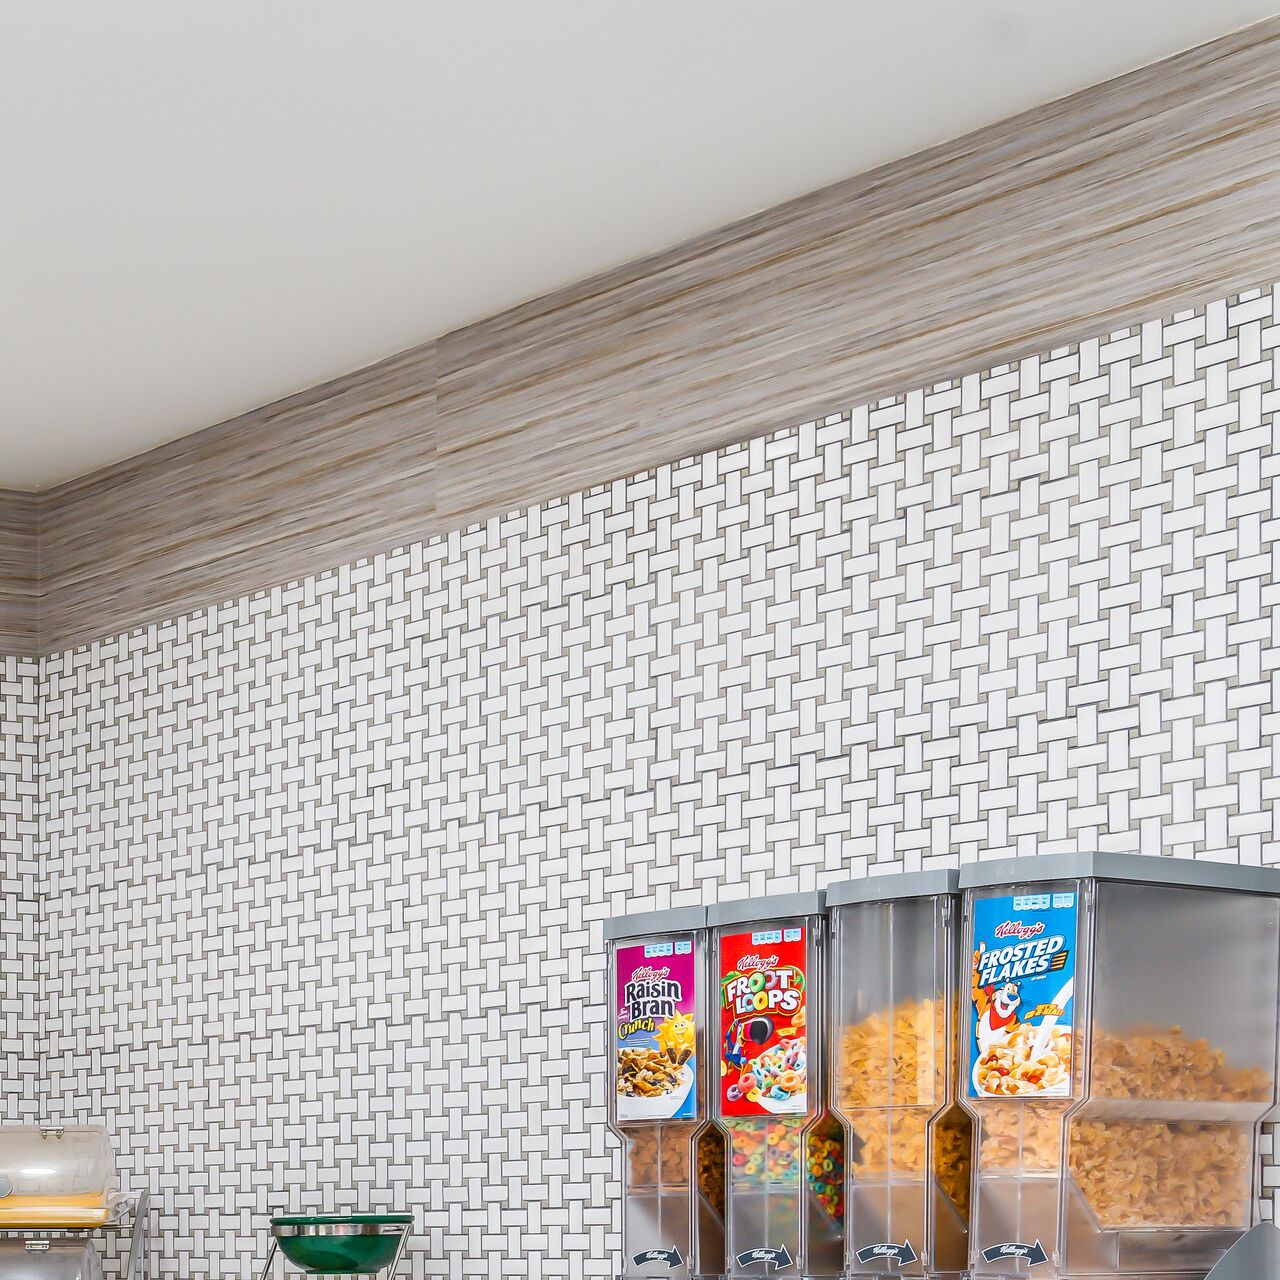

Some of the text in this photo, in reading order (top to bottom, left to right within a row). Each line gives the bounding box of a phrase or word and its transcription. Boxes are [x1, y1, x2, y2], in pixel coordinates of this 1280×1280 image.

[995, 921, 1046, 940] Kellogg's
[737, 954, 779, 971] Kellogg's
[979, 936, 1065, 972] FROSTED
[632, 966, 670, 982] Kellogg's
[979, 954, 1050, 987] FLAKES
[625, 980, 682, 1005] Raisin
[726, 968, 794, 1003] FROOT
[630, 999, 675, 1022] Bran
[735, 988, 800, 1015] LOOPS
[618, 1017, 656, 1040] Crunch
[645, 1251, 668, 1260] Kellogg's
[752, 1250, 776, 1260] Kellogg's
[872, 1245, 899, 1256] Kellogg's
[1000, 1244, 1029, 1256] Kellogg's
